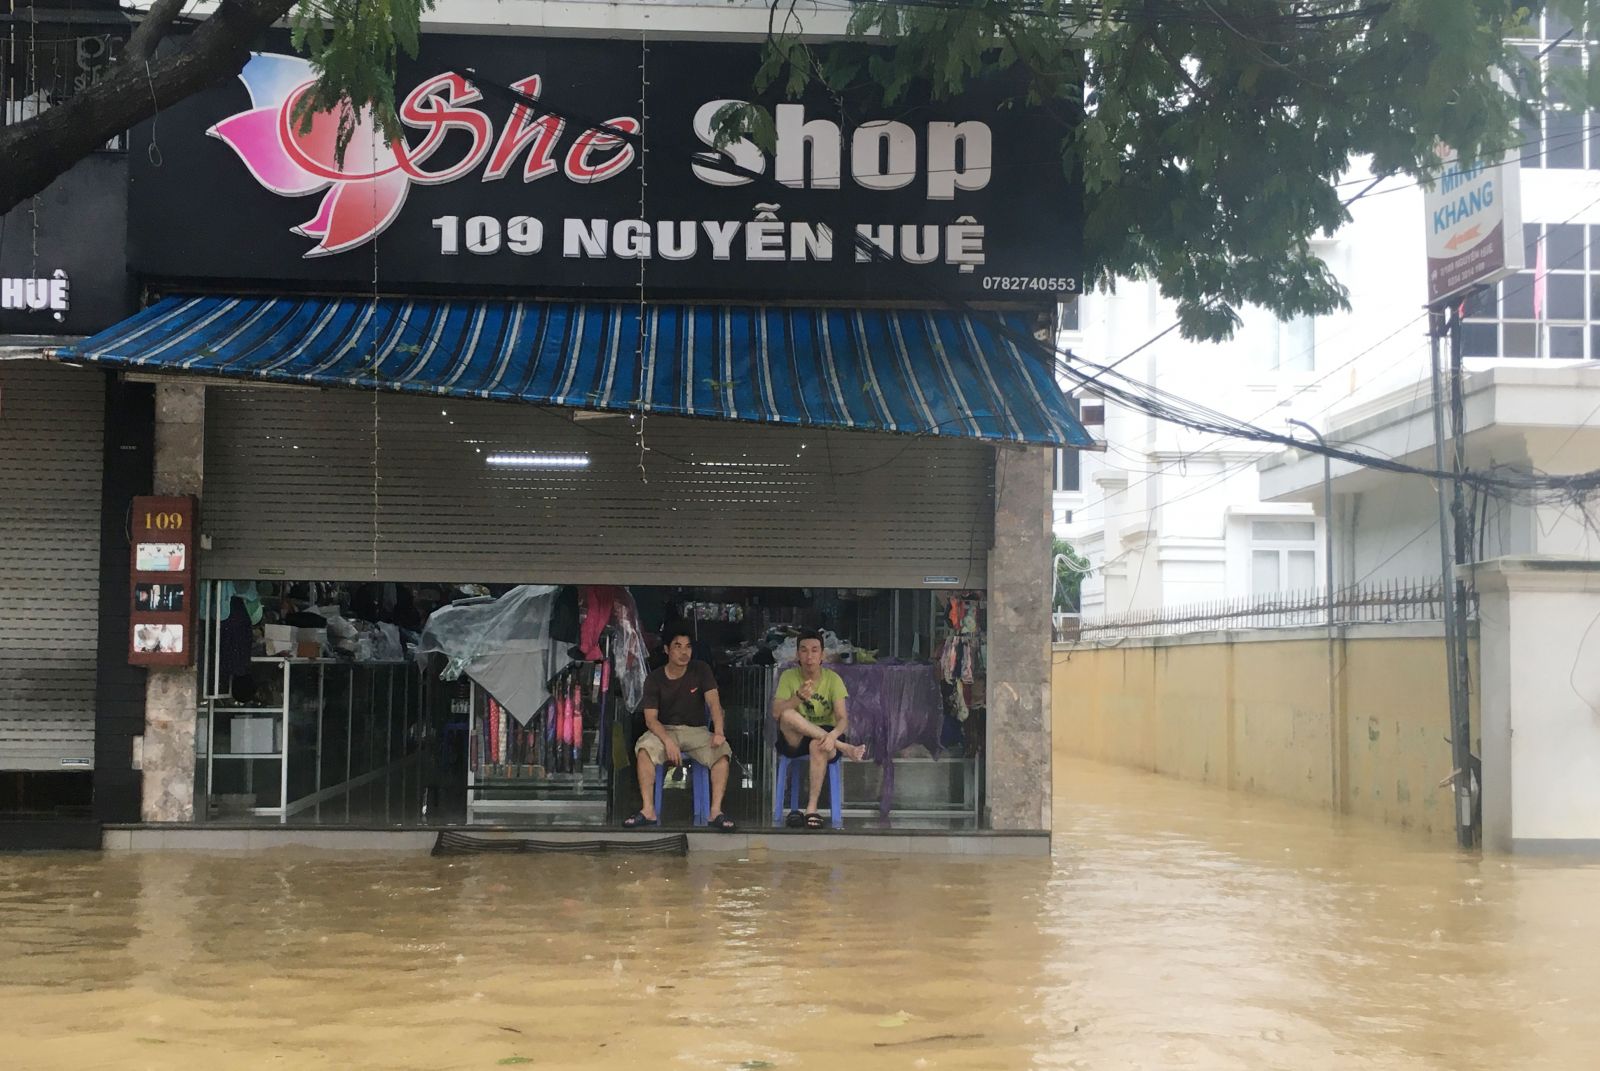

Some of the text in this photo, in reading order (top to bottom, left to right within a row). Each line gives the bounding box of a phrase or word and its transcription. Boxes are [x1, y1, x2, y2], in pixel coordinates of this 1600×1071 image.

[399, 67, 992, 201] She Shop
[1433, 180, 1494, 235] KHANG
[432, 202, 986, 274] 109 NGUYỄN HUỆ
[1, 268, 70, 323] HUỆ
[982, 276, 1076, 292] 0782740553
[145, 511, 183, 530] 109
